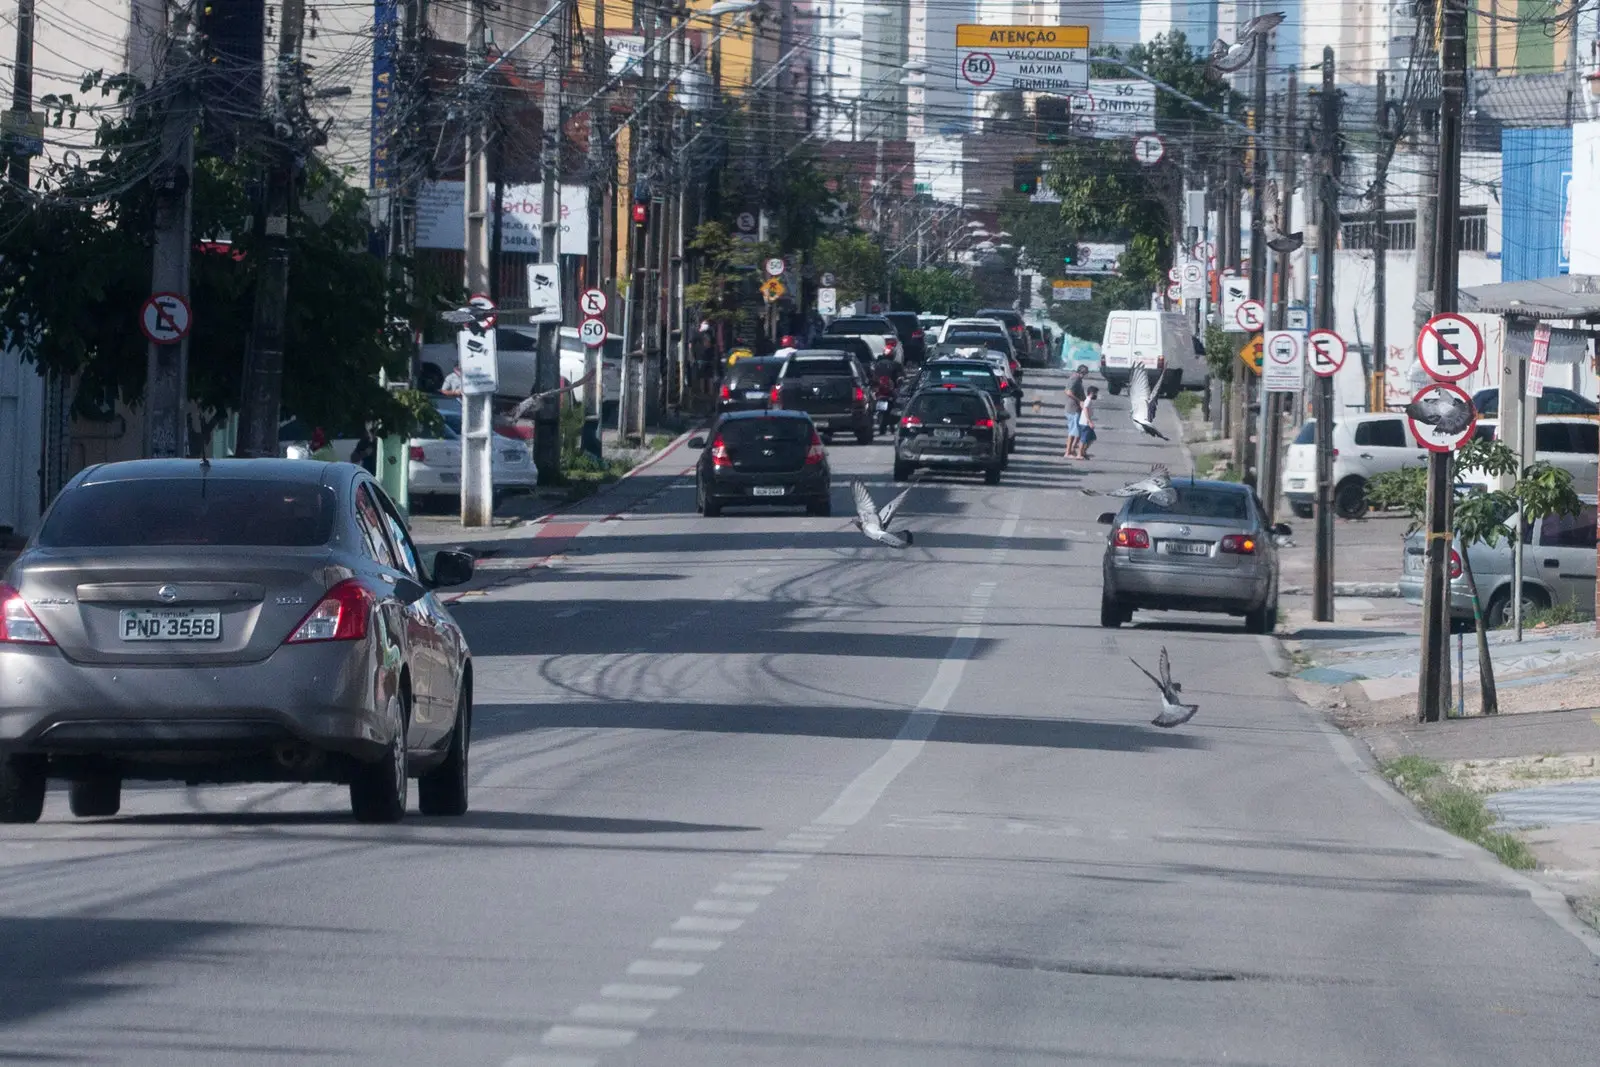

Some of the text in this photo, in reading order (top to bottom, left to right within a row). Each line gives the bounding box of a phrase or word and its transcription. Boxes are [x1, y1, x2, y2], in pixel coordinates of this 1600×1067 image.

[990, 31, 1056, 45] ATENÇÃO
[1007, 51, 1076, 60] VELOCIDADE
[968, 59, 990, 73] 50
[1019, 62, 1063, 75] MÁXIMA
[1012, 79, 1070, 89] PERMITIDA
[1098, 98, 1150, 112] ÔNIBUS
[770, 262, 782, 270] 50
[588, 293, 600, 310] E
[156, 302, 177, 332] E
[1246, 307, 1257, 324] E
[584, 324, 603, 336] 50
[1315, 339, 1331, 365] E
[1437, 328, 1461, 366] E
